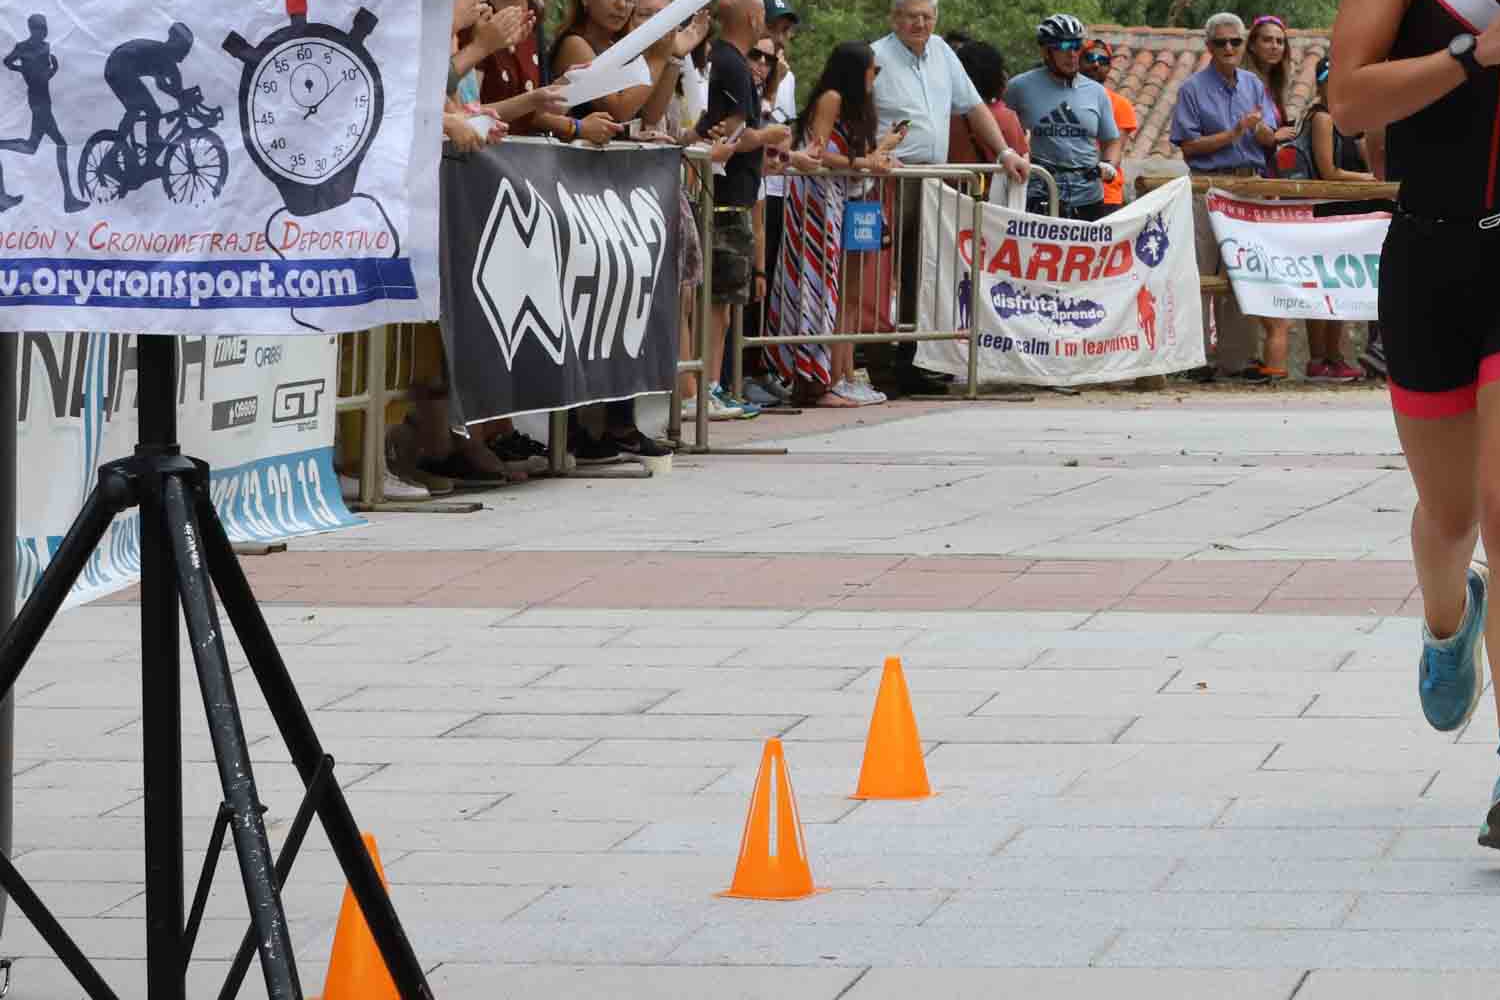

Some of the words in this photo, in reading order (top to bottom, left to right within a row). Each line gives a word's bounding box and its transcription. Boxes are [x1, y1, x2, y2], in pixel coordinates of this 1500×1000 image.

[297, 48, 313, 60] 60
[323, 52, 332, 65] 5
[274, 60, 290, 74] 55
[341, 69, 356, 81] 10
[263, 81, 278, 94] 50
[260, 112, 275, 125] 45
[270, 138, 286, 150] 40
[290, 154, 306, 167] 35
[65, 230, 80, 252] Y
[993, 294, 1058, 316] disfruta
